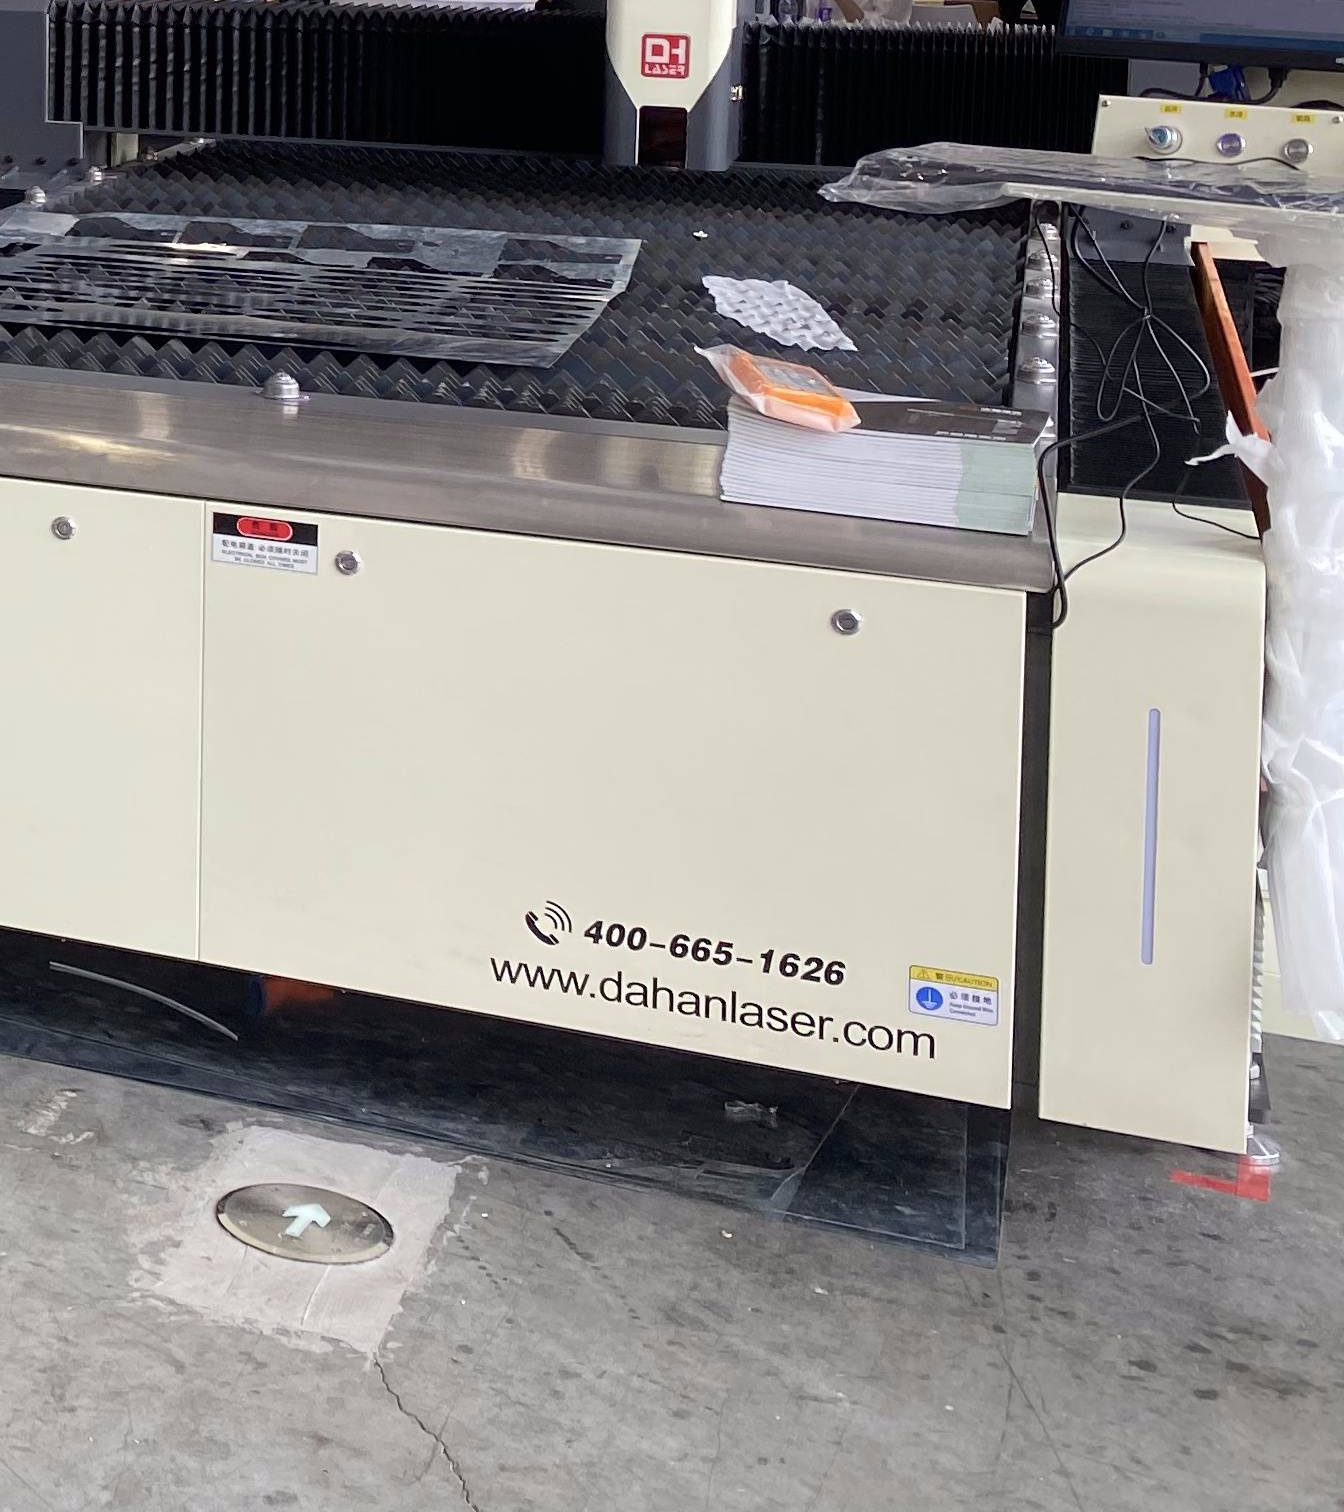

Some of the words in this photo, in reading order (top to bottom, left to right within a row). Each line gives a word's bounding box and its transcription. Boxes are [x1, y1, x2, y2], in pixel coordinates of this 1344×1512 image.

[645, 38, 687, 64] DH
[645, 63, 685, 76] LASER
[584, 919, 847, 986] 400-665-1626
[490, 957, 935, 1059] www.dahanlaser.com
